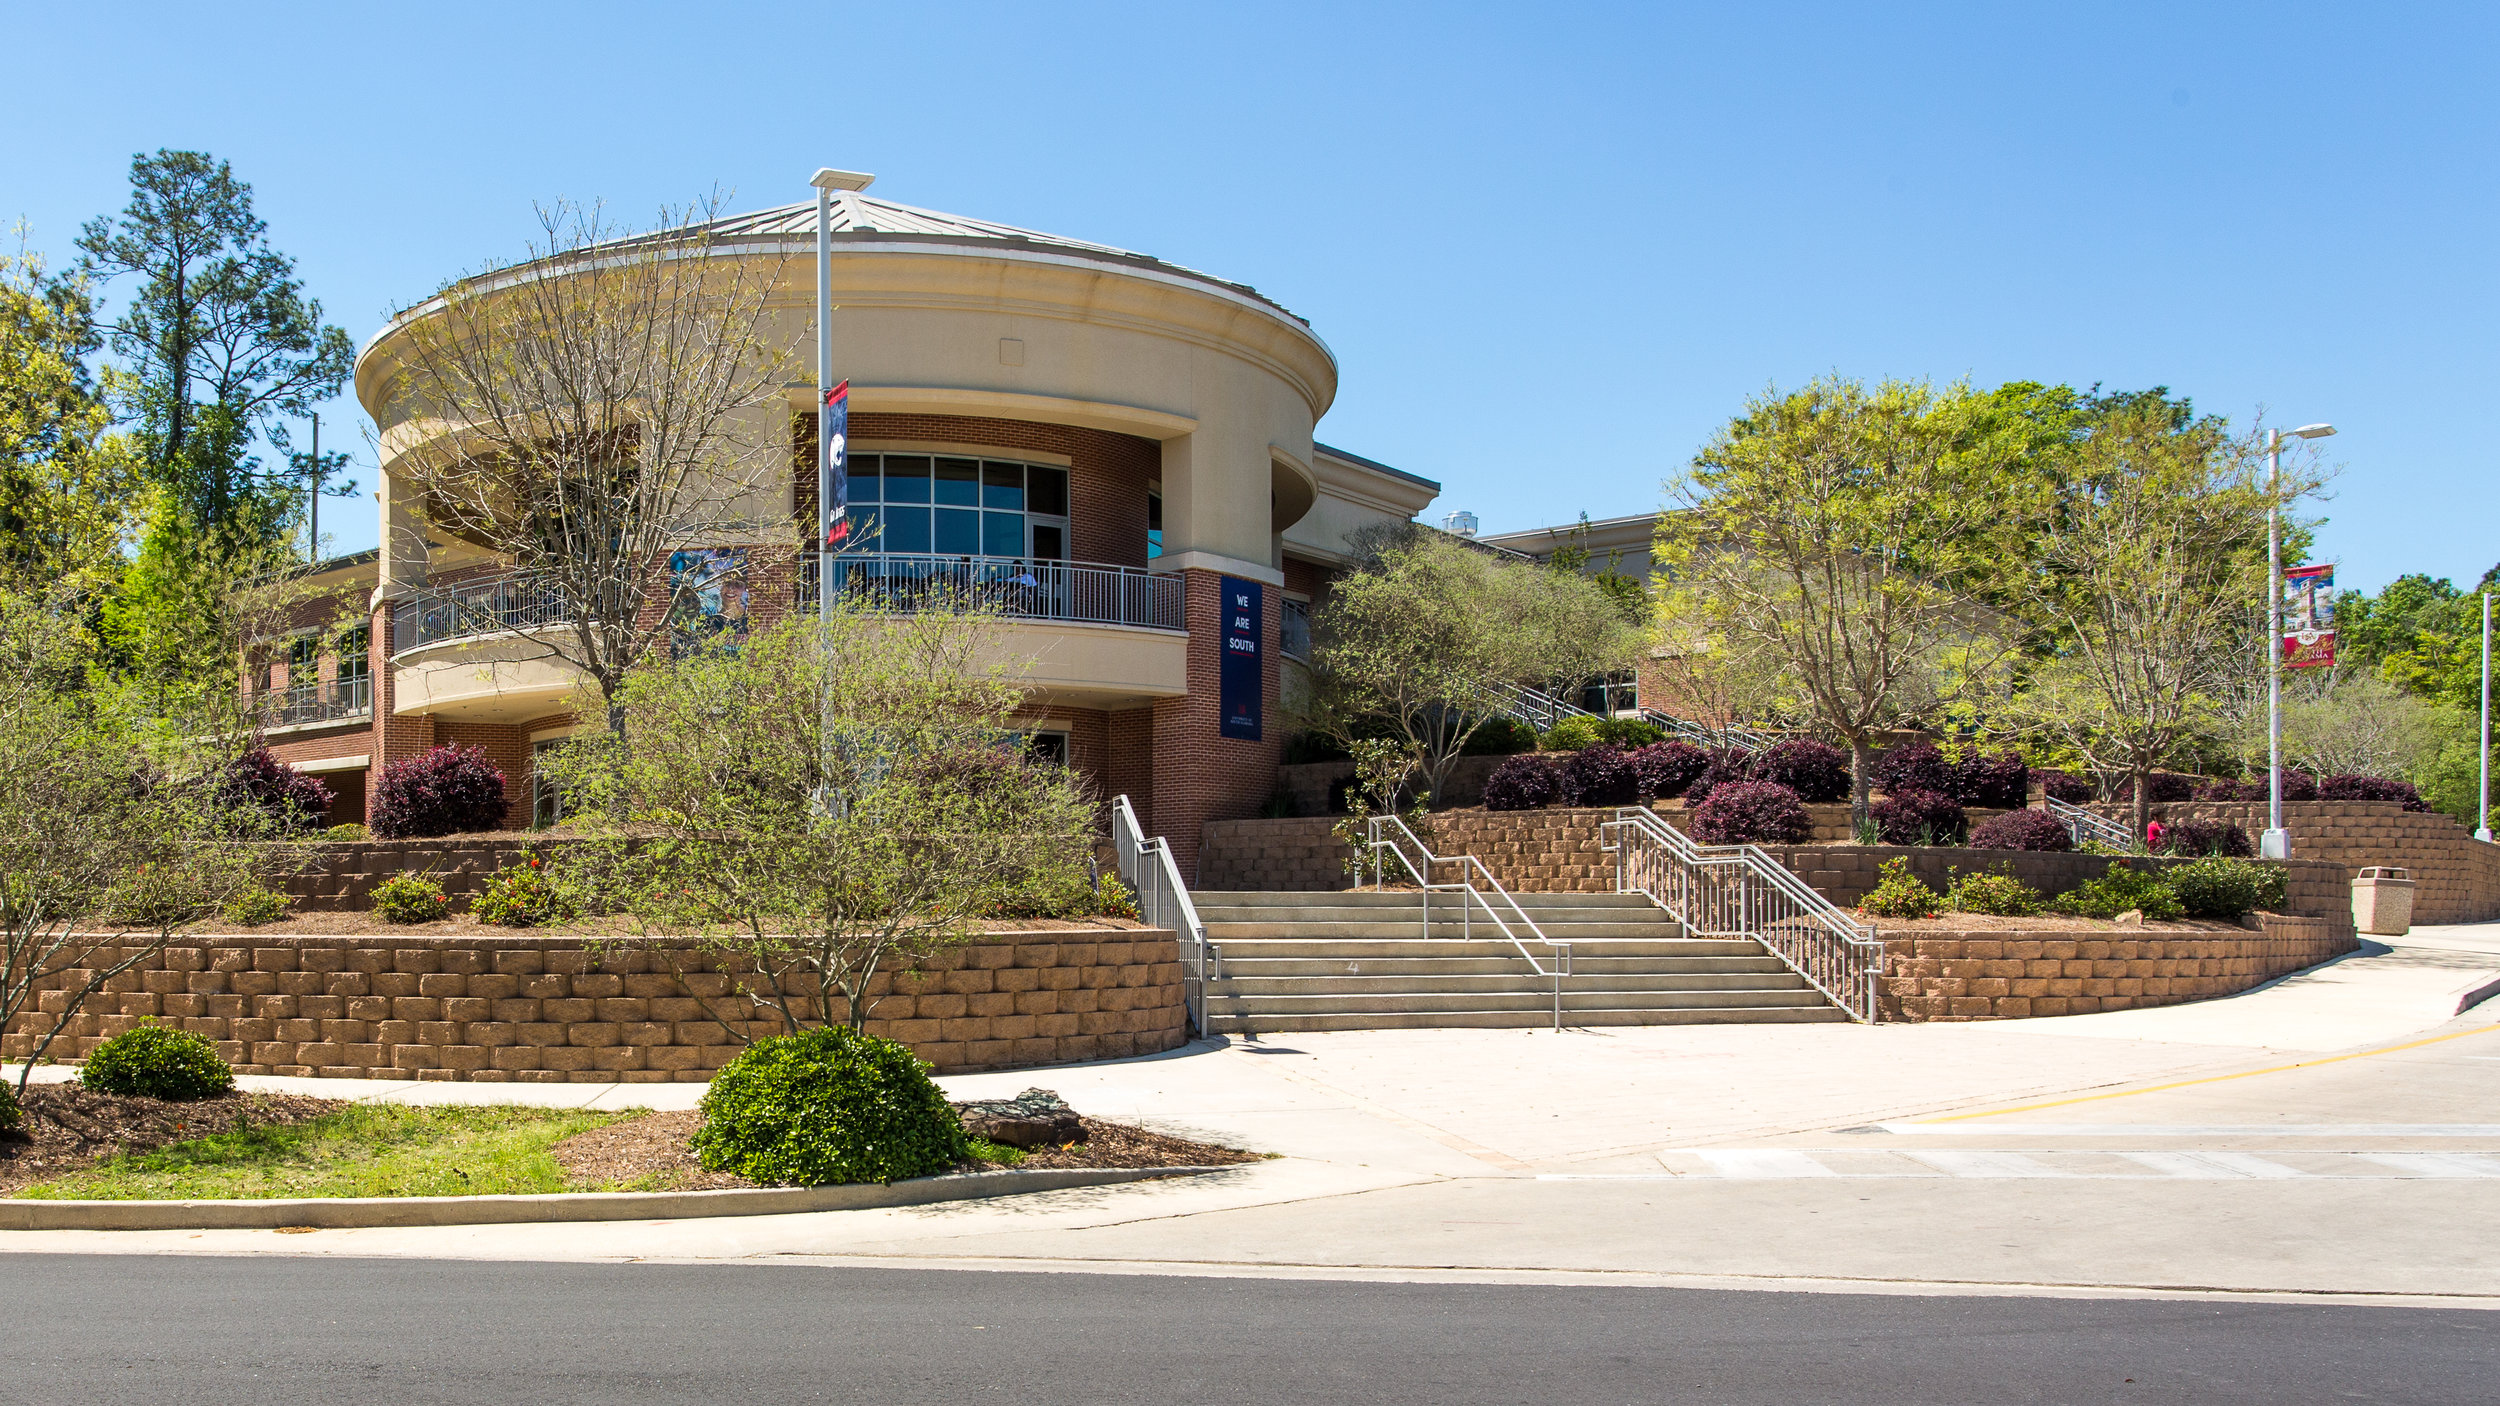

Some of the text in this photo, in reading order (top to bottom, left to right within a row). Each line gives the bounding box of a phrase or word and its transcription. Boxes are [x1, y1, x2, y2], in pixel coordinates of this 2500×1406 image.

[1237, 594, 1248, 607] WE
[1235, 617, 1250, 630] ARE
[1229, 637, 1254, 653] SOUTH
